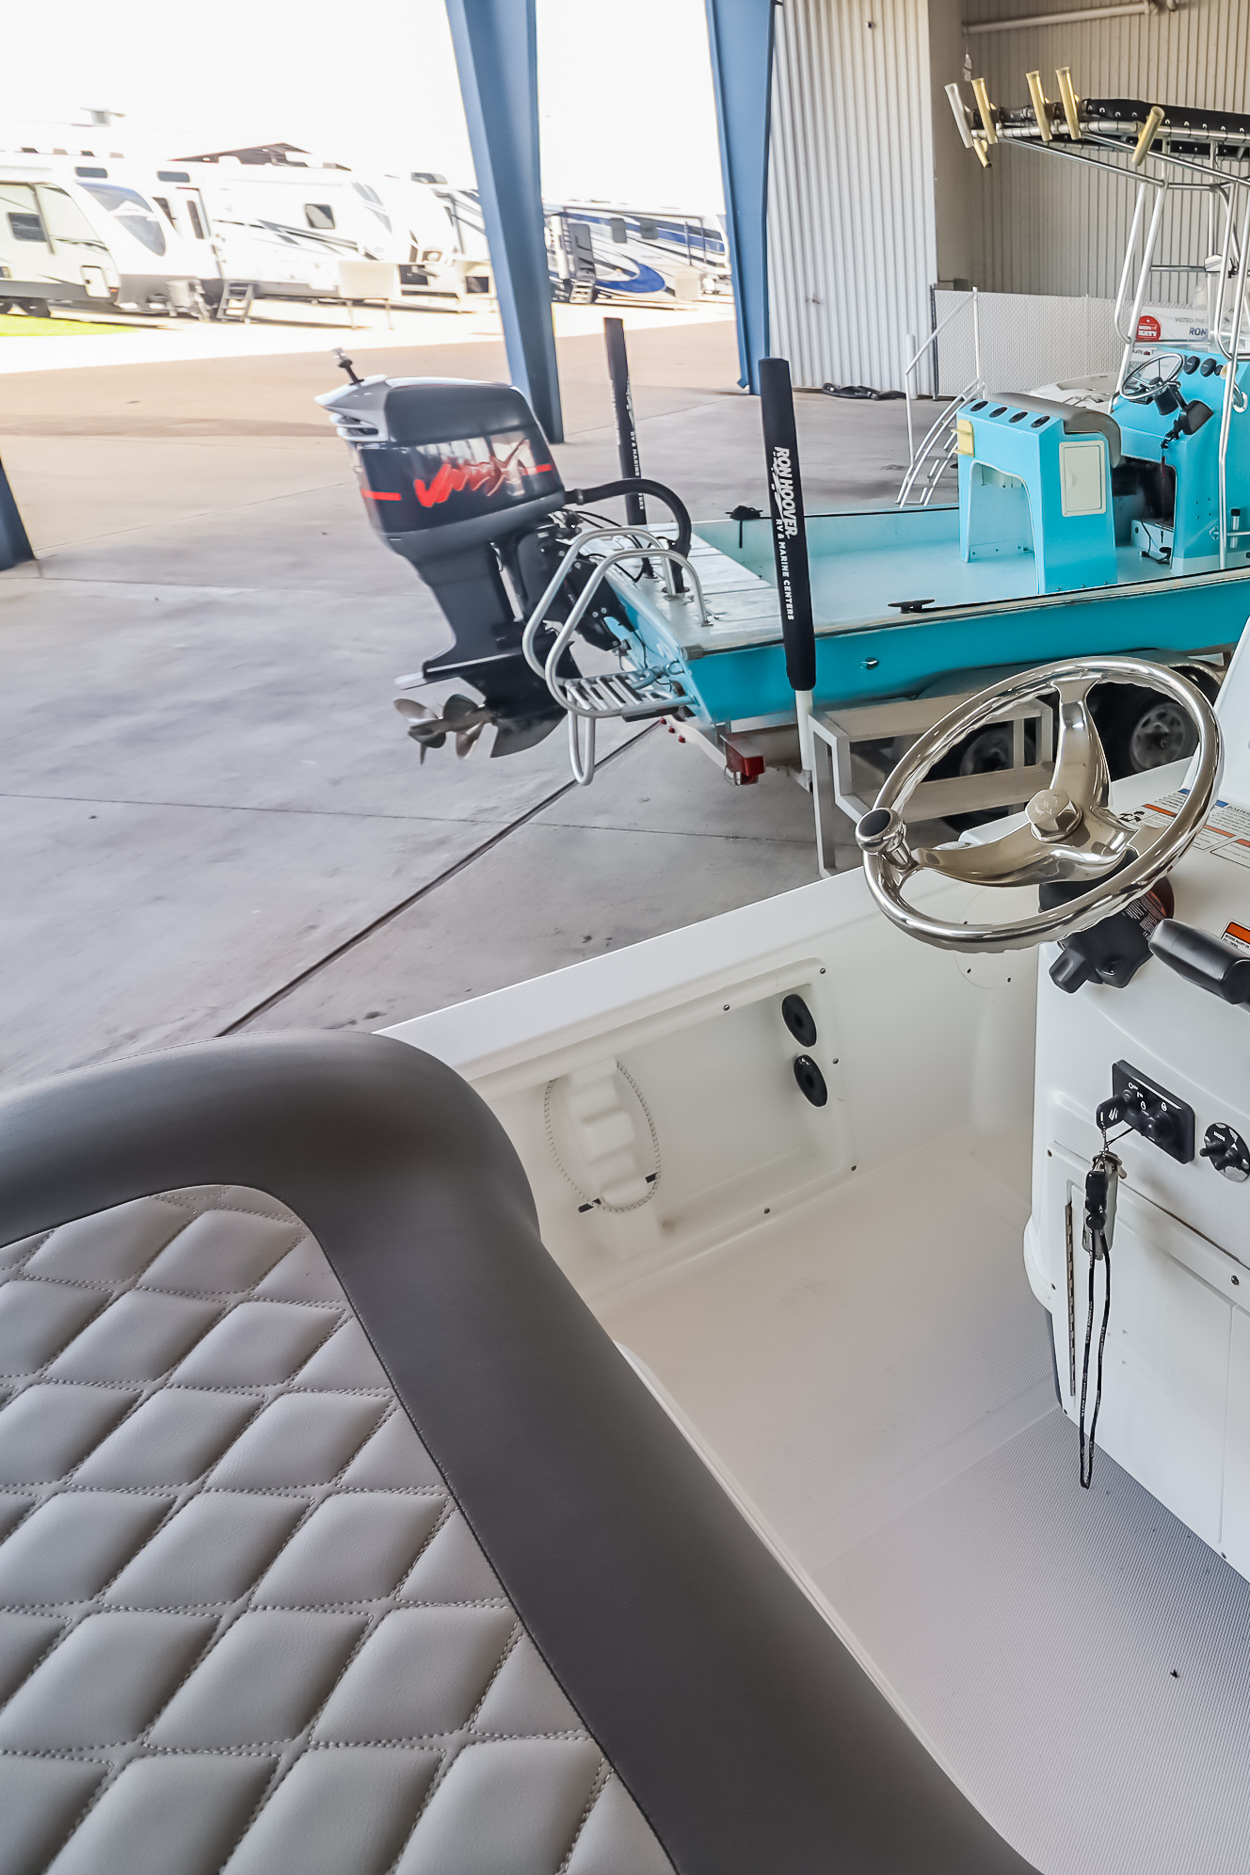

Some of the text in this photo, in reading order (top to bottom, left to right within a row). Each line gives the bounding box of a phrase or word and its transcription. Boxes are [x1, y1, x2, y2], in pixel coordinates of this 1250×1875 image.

[1189, 327, 1207, 336] RON
[632, 448, 640, 477] MARINE
[774, 446, 799, 540] RON HOOVER
[775, 519, 784, 533] RV
[778, 541, 790, 578] MARINE
[783, 579, 795, 621] CENTERS
